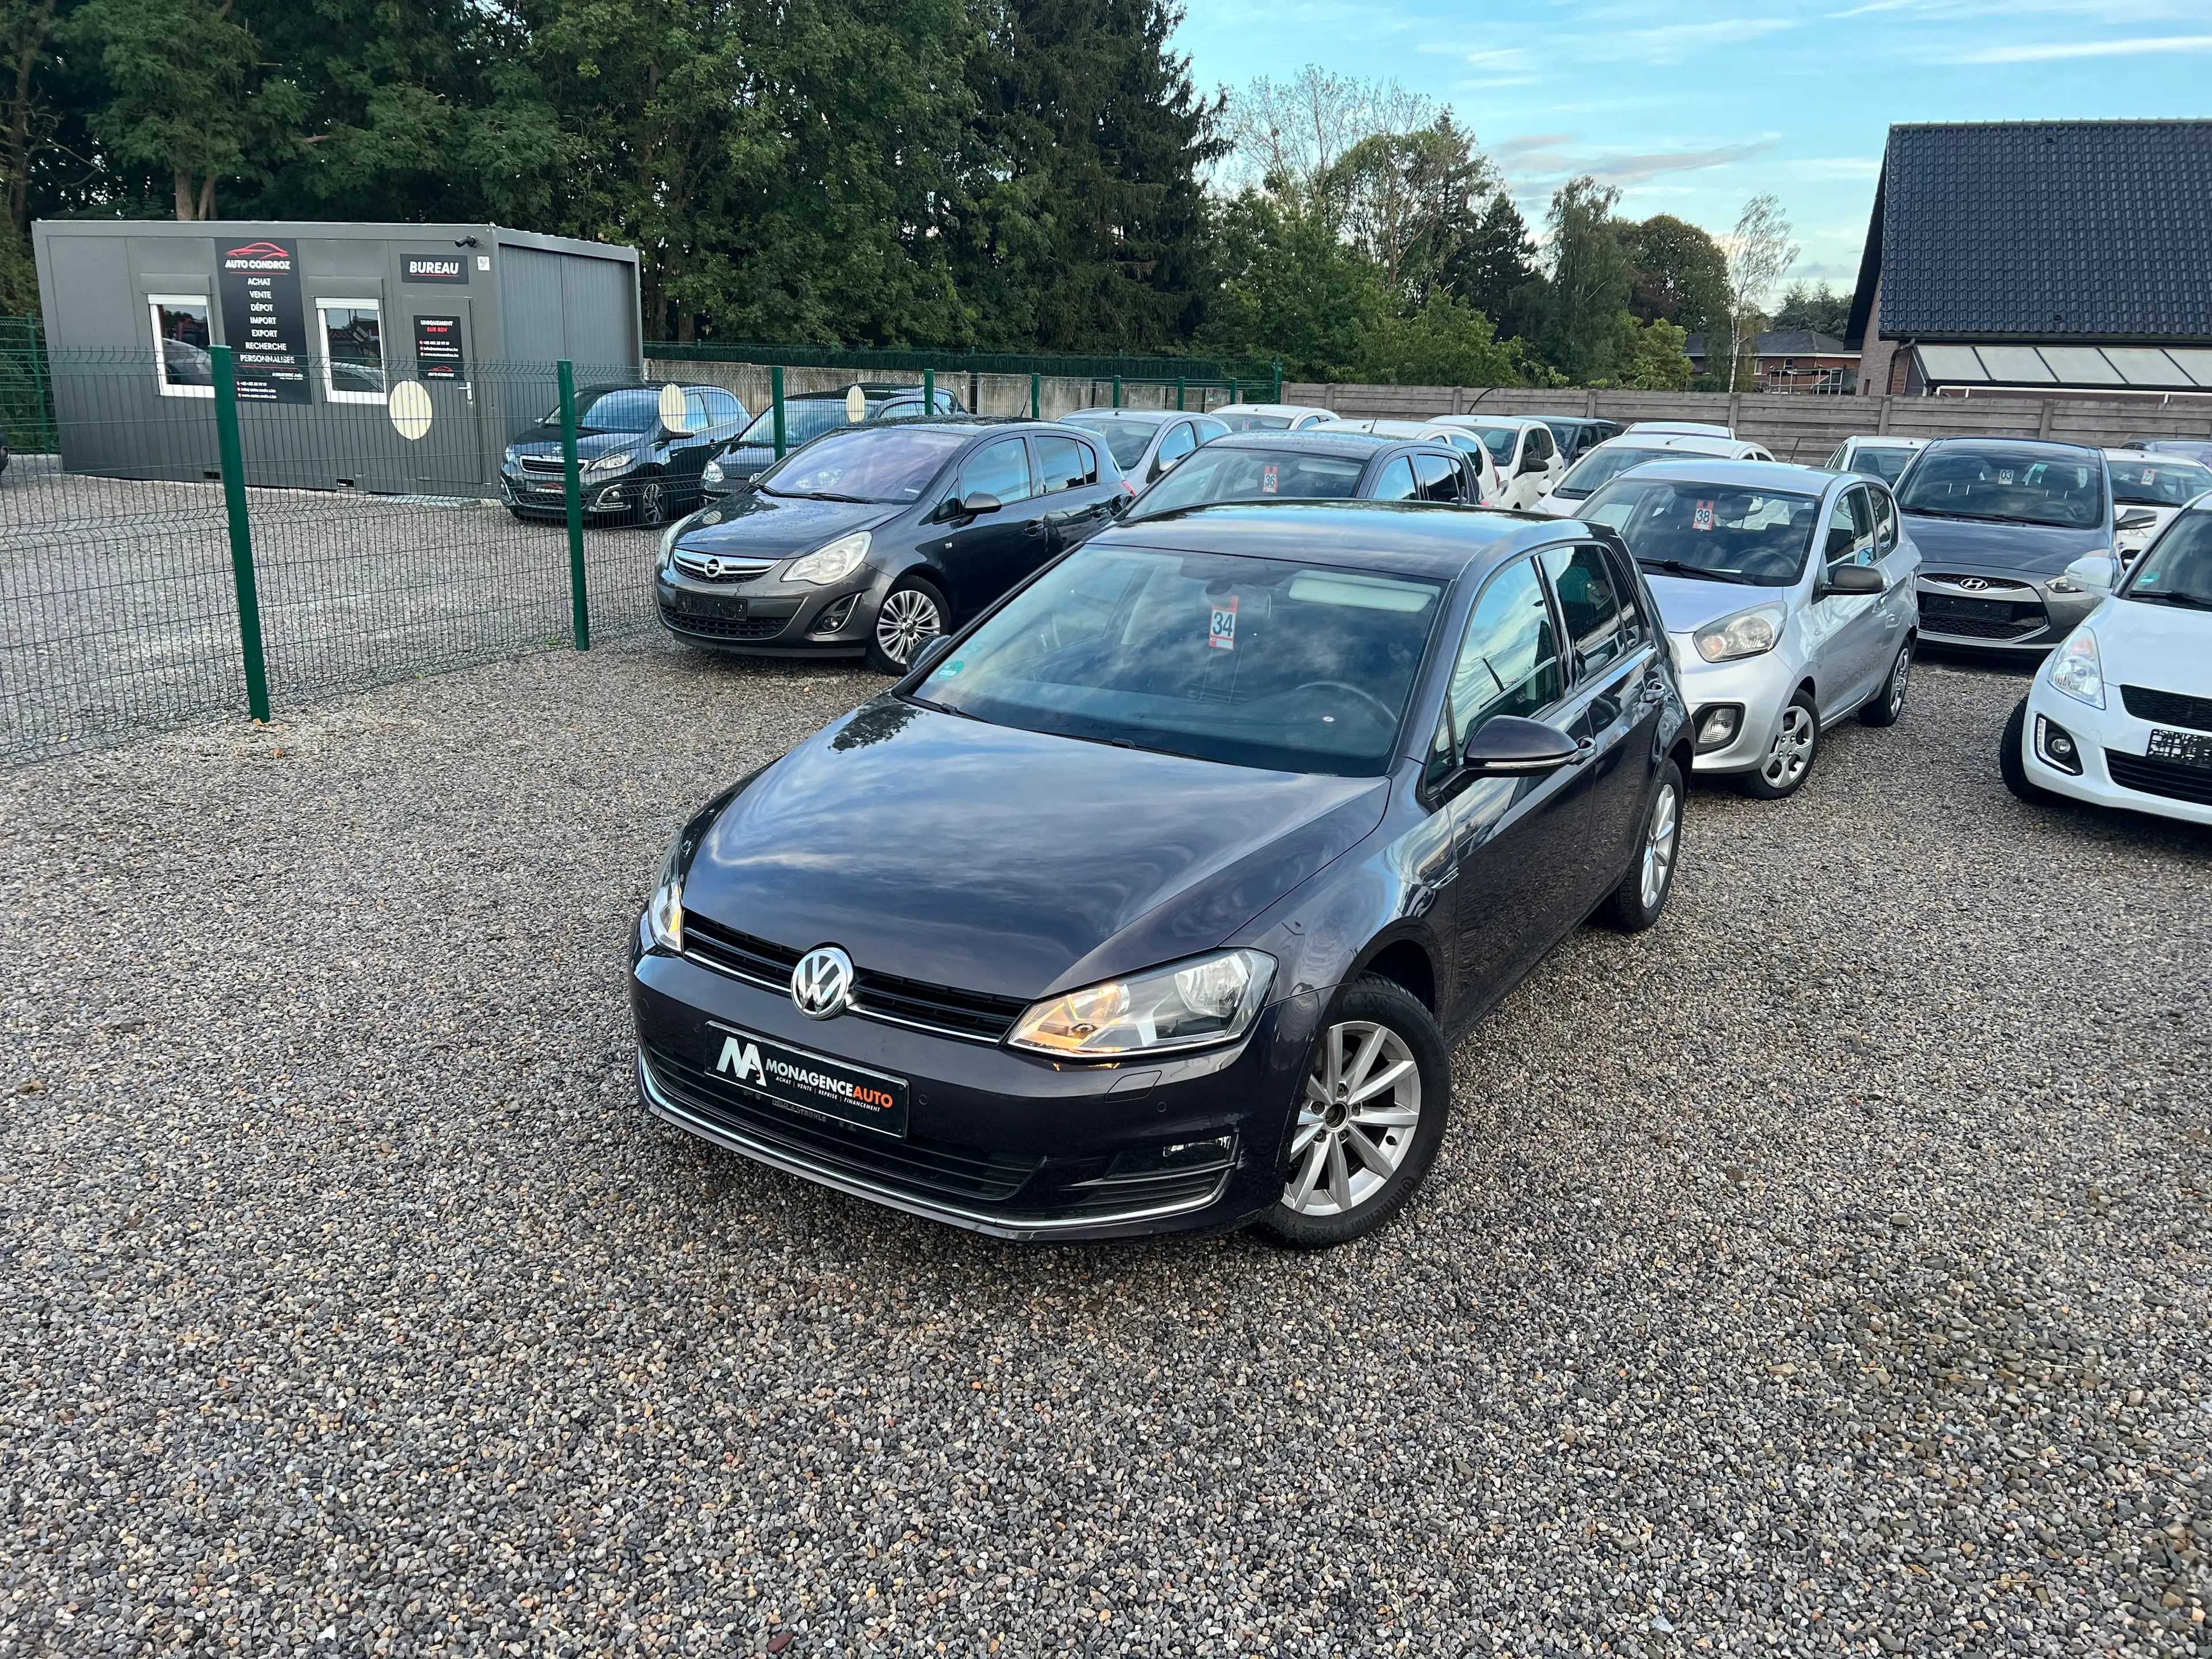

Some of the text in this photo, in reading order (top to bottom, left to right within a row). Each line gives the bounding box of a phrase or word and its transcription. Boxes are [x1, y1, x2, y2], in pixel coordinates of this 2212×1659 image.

[225, 259, 290, 270] AUTO CONDROZ
[409, 261, 459, 274] BUREAU
[247, 278, 271, 286] ACHAT
[249, 290, 272, 299] VENTE
[250, 302, 273, 312] DÉPOT
[249, 316, 276, 325] IMPORT
[251, 329, 278, 338] EXPORT
[245, 342, 287, 351] RECHERCHE
[2001, 470, 2012, 479] 03
[1265, 475, 1275, 486] 36
[1696, 509, 1710, 522] 38
[1213, 611, 1233, 637] 34
[775, 1076, 881, 1112] ACHAT VENTE REPRISE FINANCEMENT
